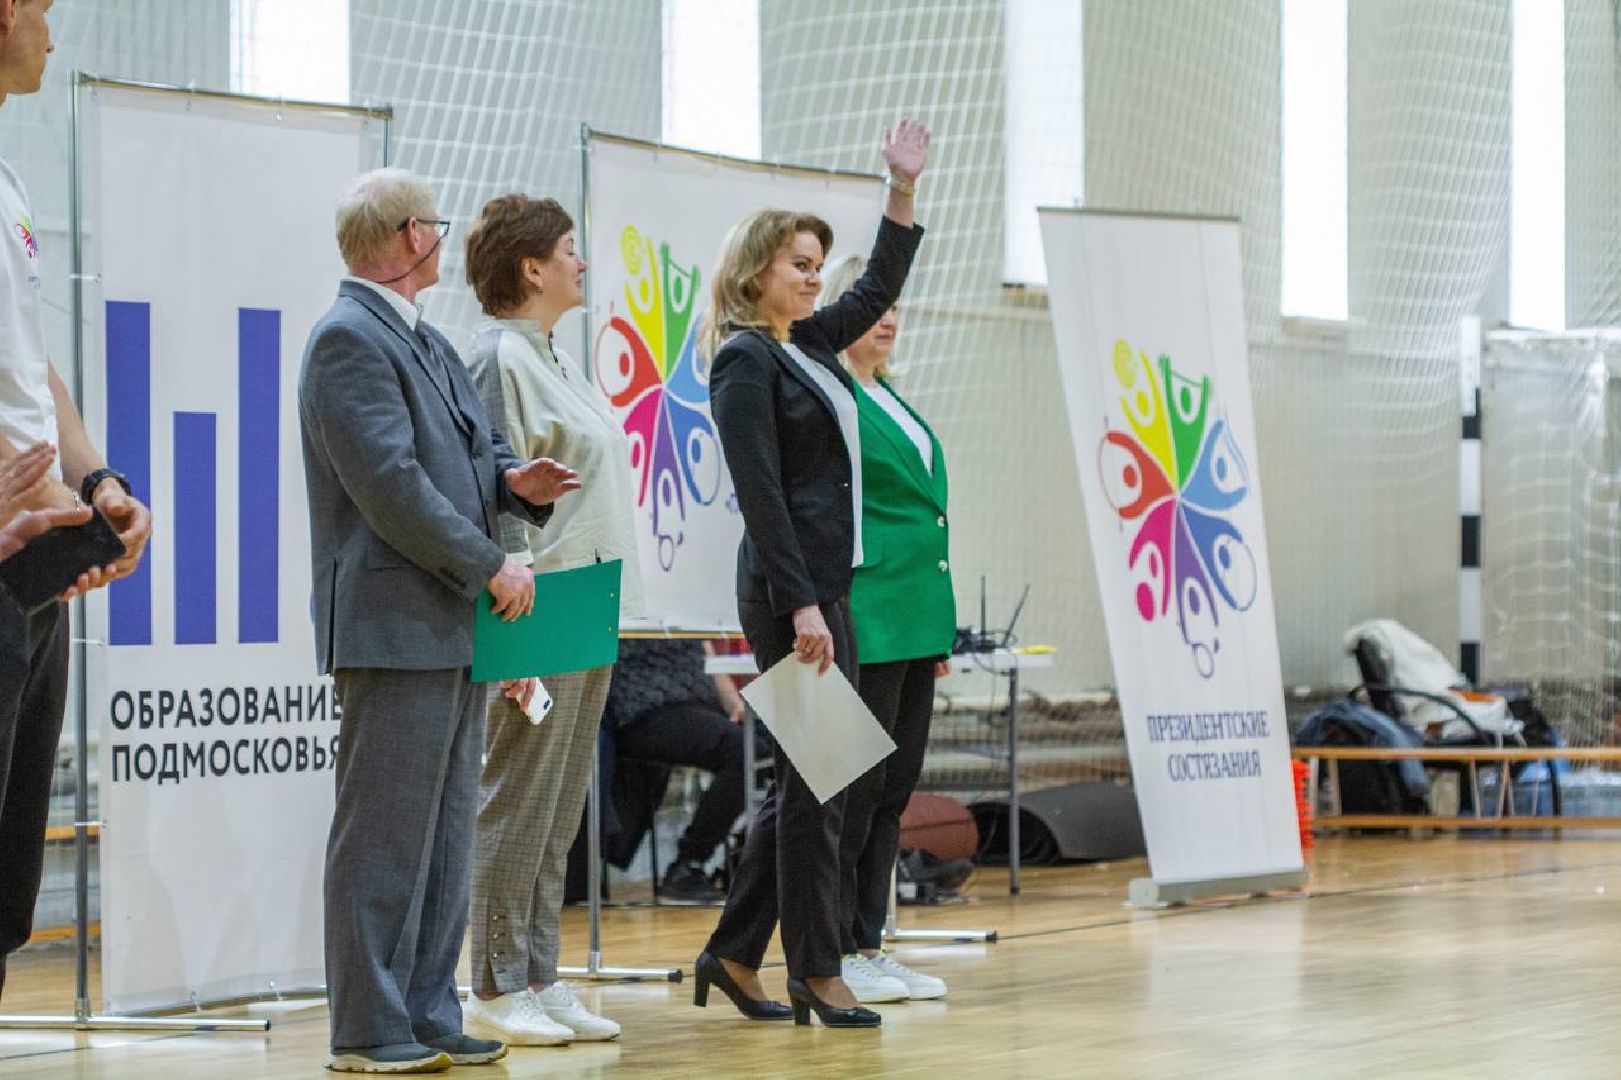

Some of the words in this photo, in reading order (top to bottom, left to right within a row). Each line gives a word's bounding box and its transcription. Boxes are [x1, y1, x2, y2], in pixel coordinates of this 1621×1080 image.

[110, 684, 342, 730] ОБРАЗОВАНИЕ
[1147, 710, 1270, 743] ПРЕЗИДЕНТСКИЕ
[1168, 750, 1261, 781] СОСТЯЗАНИЯ
